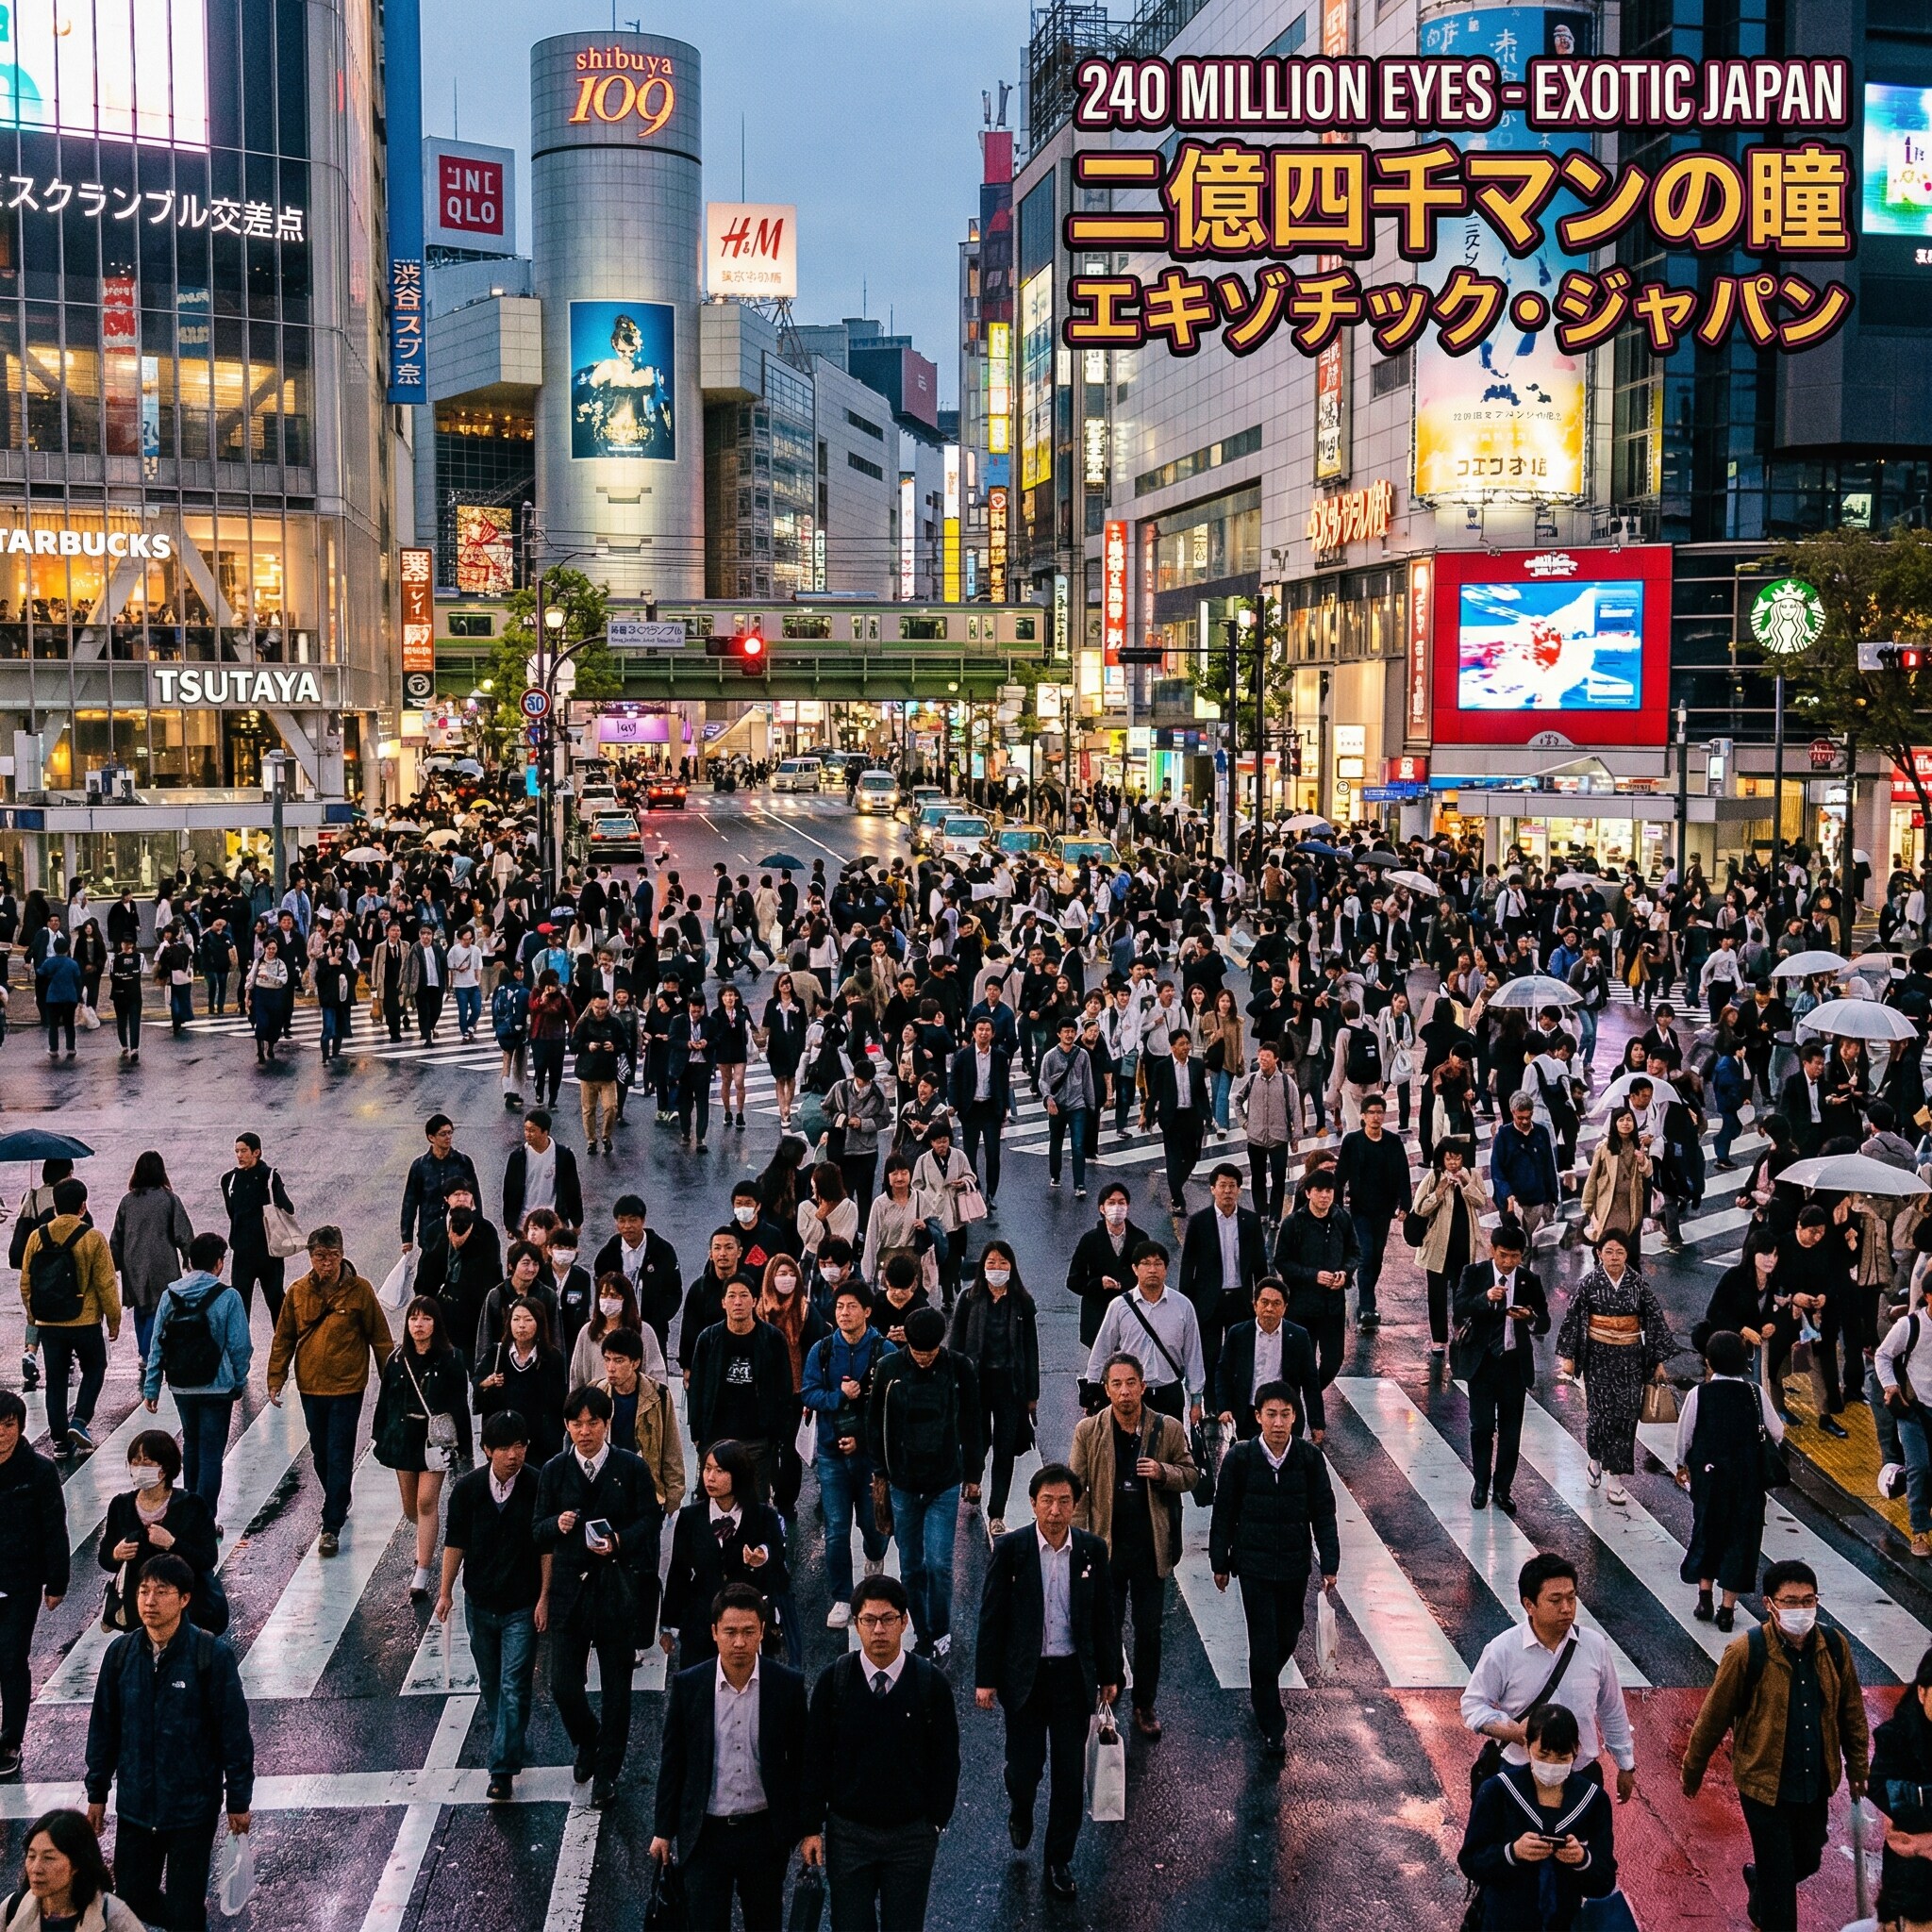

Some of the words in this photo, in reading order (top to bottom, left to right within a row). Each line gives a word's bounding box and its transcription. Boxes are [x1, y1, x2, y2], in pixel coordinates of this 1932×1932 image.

[576, 47, 674, 78] shibuya
[569, 75, 675, 139] 109
[0, 174, 305, 242] スクランブル交差点
[446, 196, 496, 225] QLO
[720, 216, 785, 261] H&M
[154, 669, 322, 704] TSUTAYA
